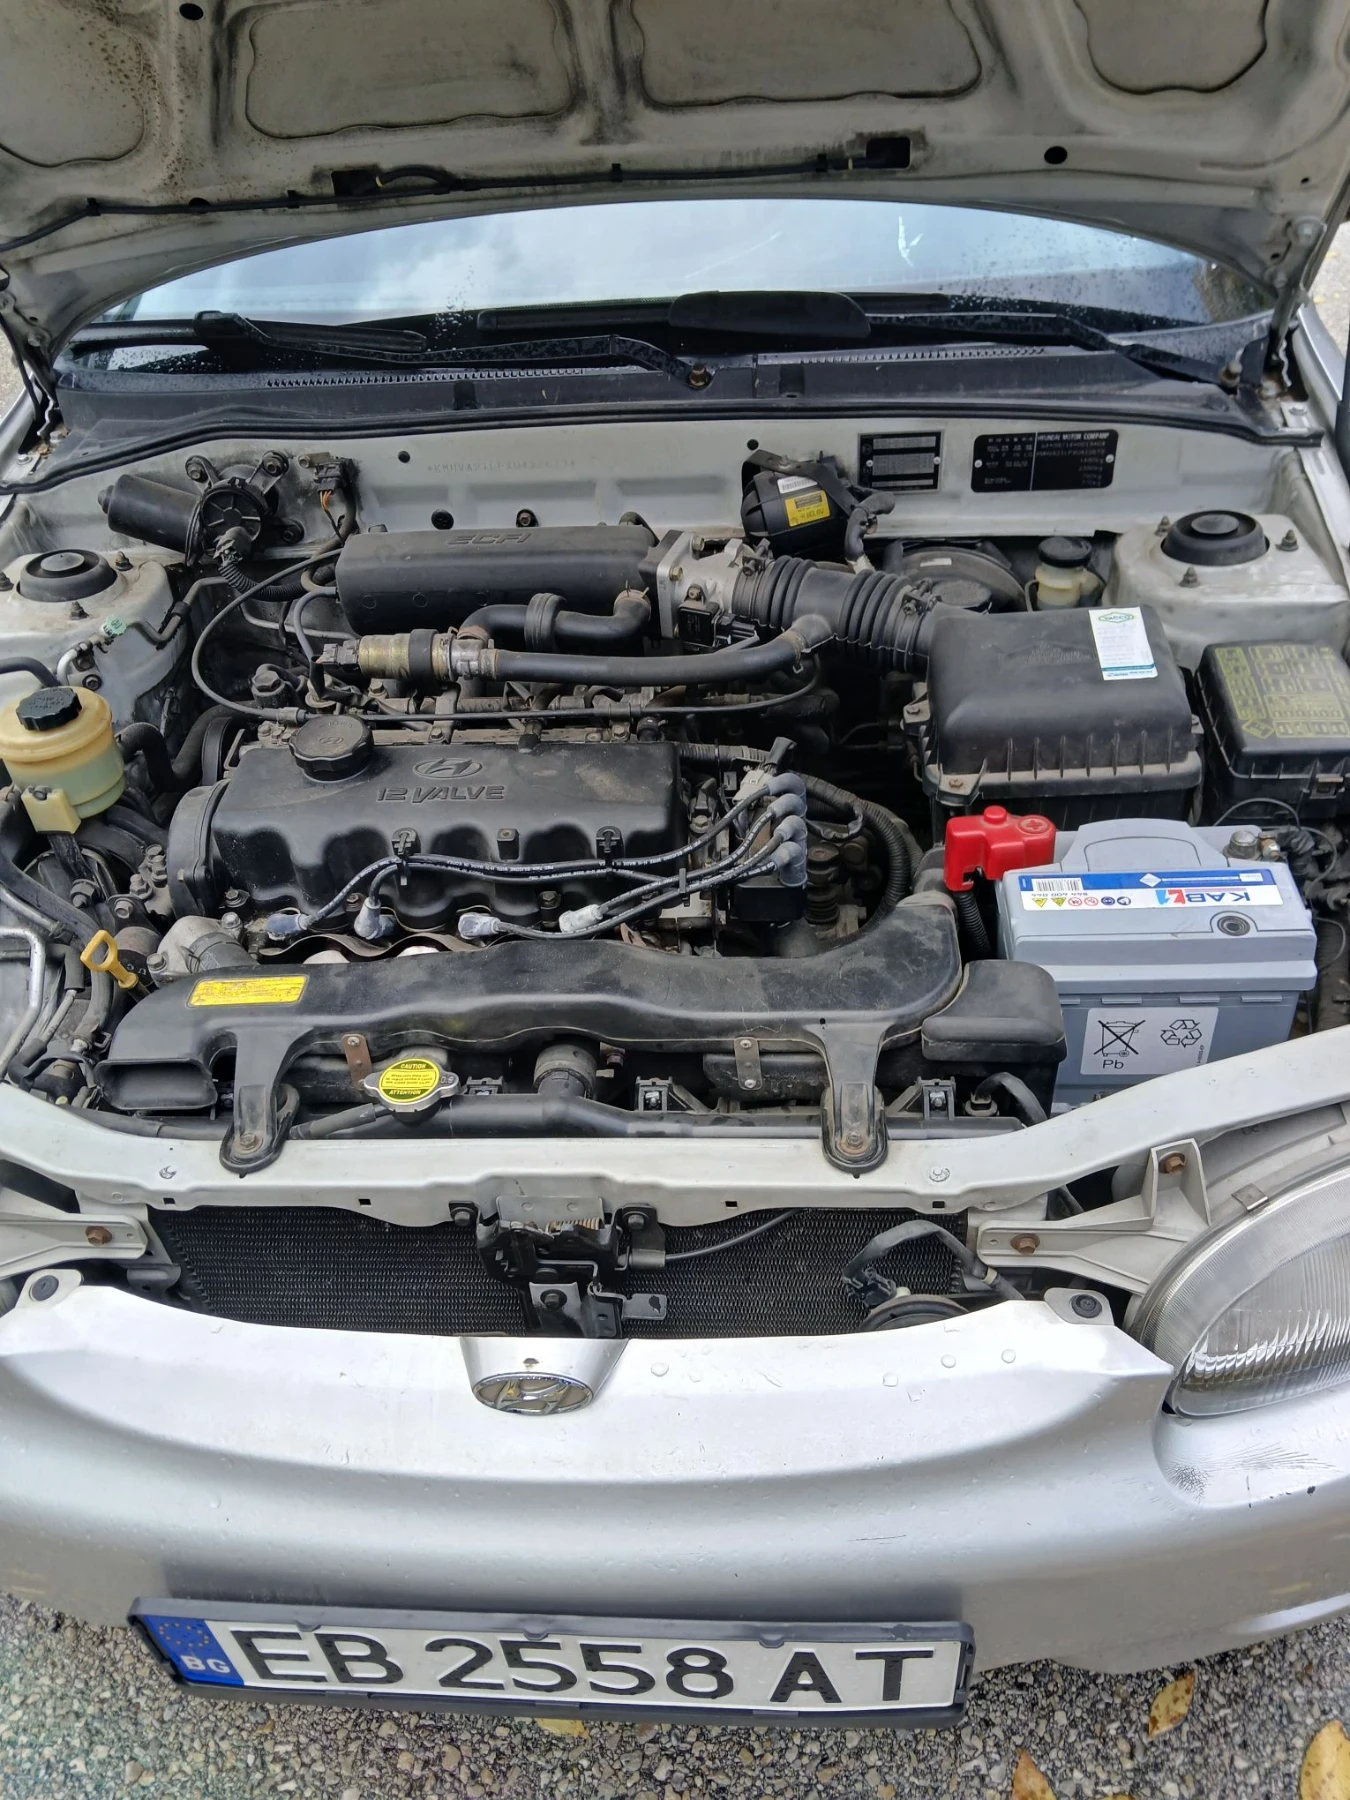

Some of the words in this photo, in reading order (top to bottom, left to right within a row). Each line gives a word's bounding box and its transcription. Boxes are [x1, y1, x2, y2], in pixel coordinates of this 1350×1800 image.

[1062, 432, 1082, 440] MOTOR
[377, 787, 409, 802] 12
[411, 785, 505, 804] VALVE
[1102, 1059, 1124, 1070] Pb
[440, 1076, 455, 1084] 0.9
[179, 1655, 231, 1674] BG
[230, 1629, 404, 1684] EB
[424, 1636, 735, 1700] 2558
[769, 1649, 934, 1704] AT
